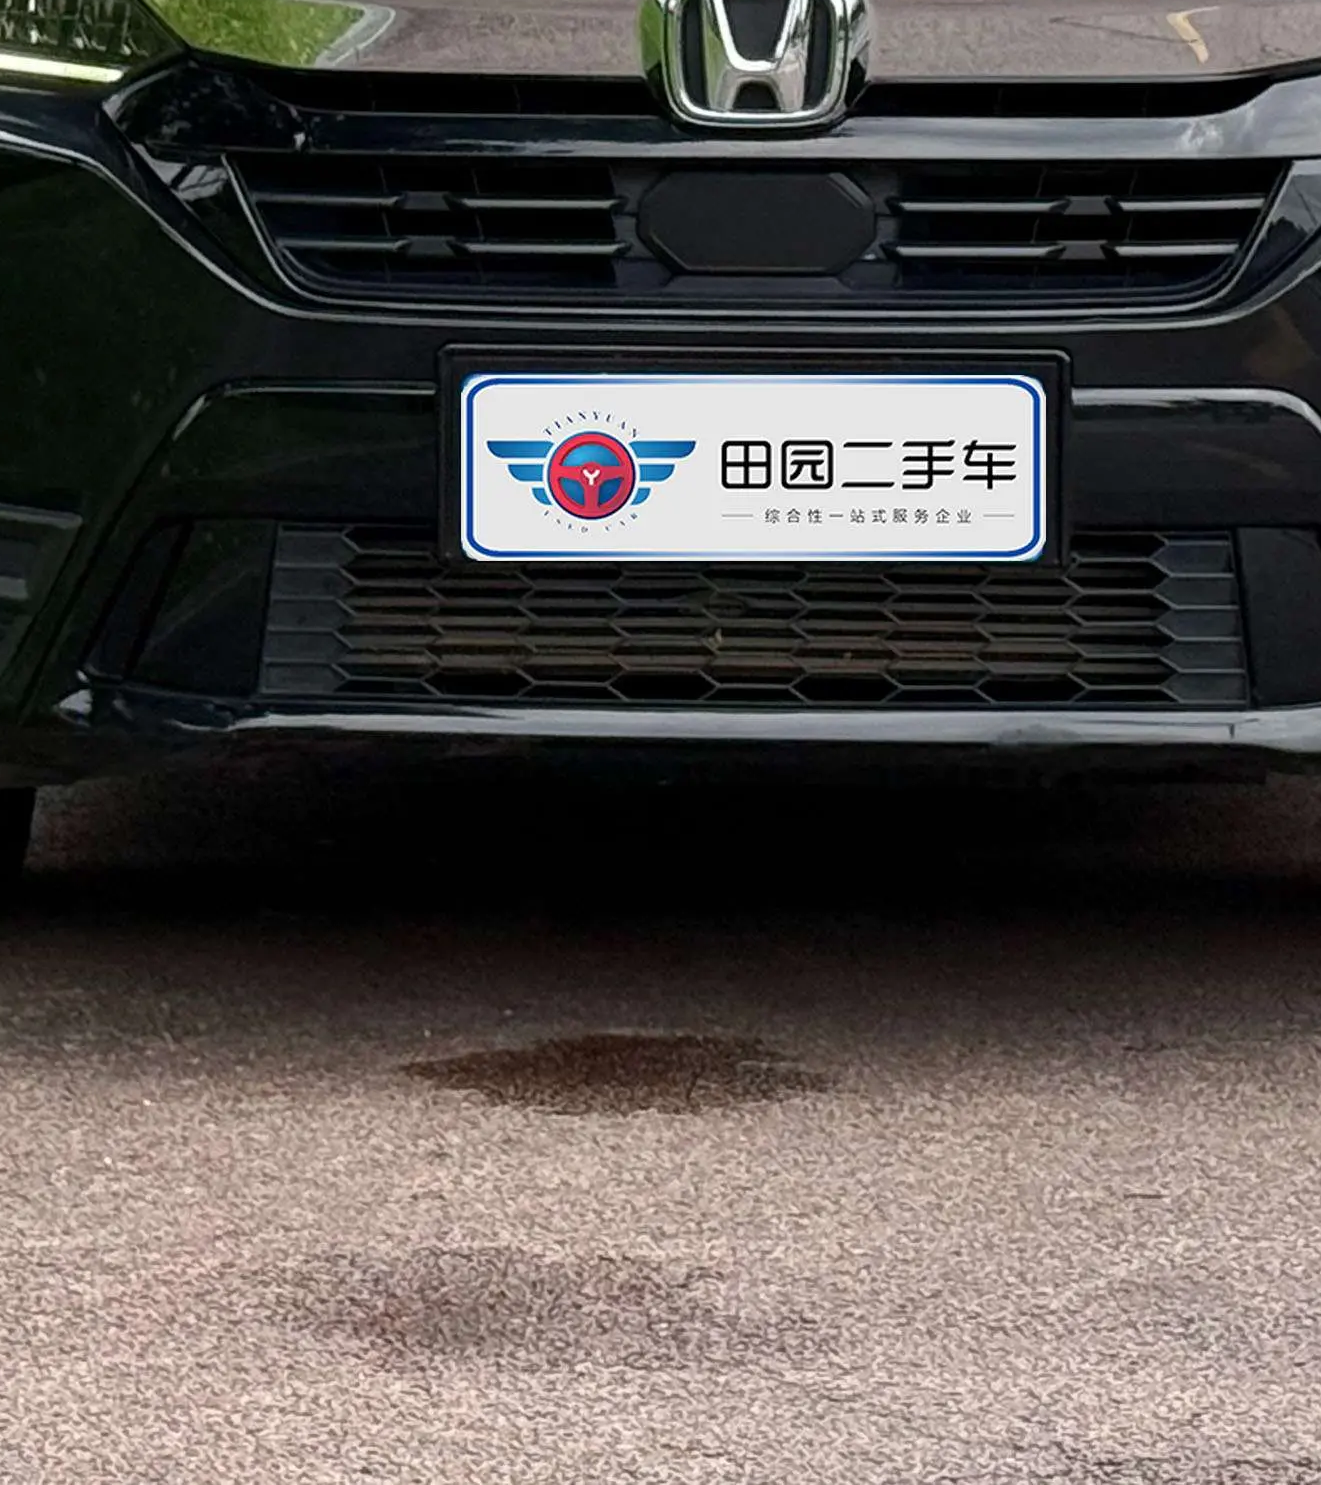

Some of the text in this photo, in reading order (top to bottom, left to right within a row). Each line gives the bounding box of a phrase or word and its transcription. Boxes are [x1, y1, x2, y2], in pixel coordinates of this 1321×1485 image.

[721, 439, 1017, 490] 田园二手车
[764, 507, 972, 525] 综合性一站式服务企业
